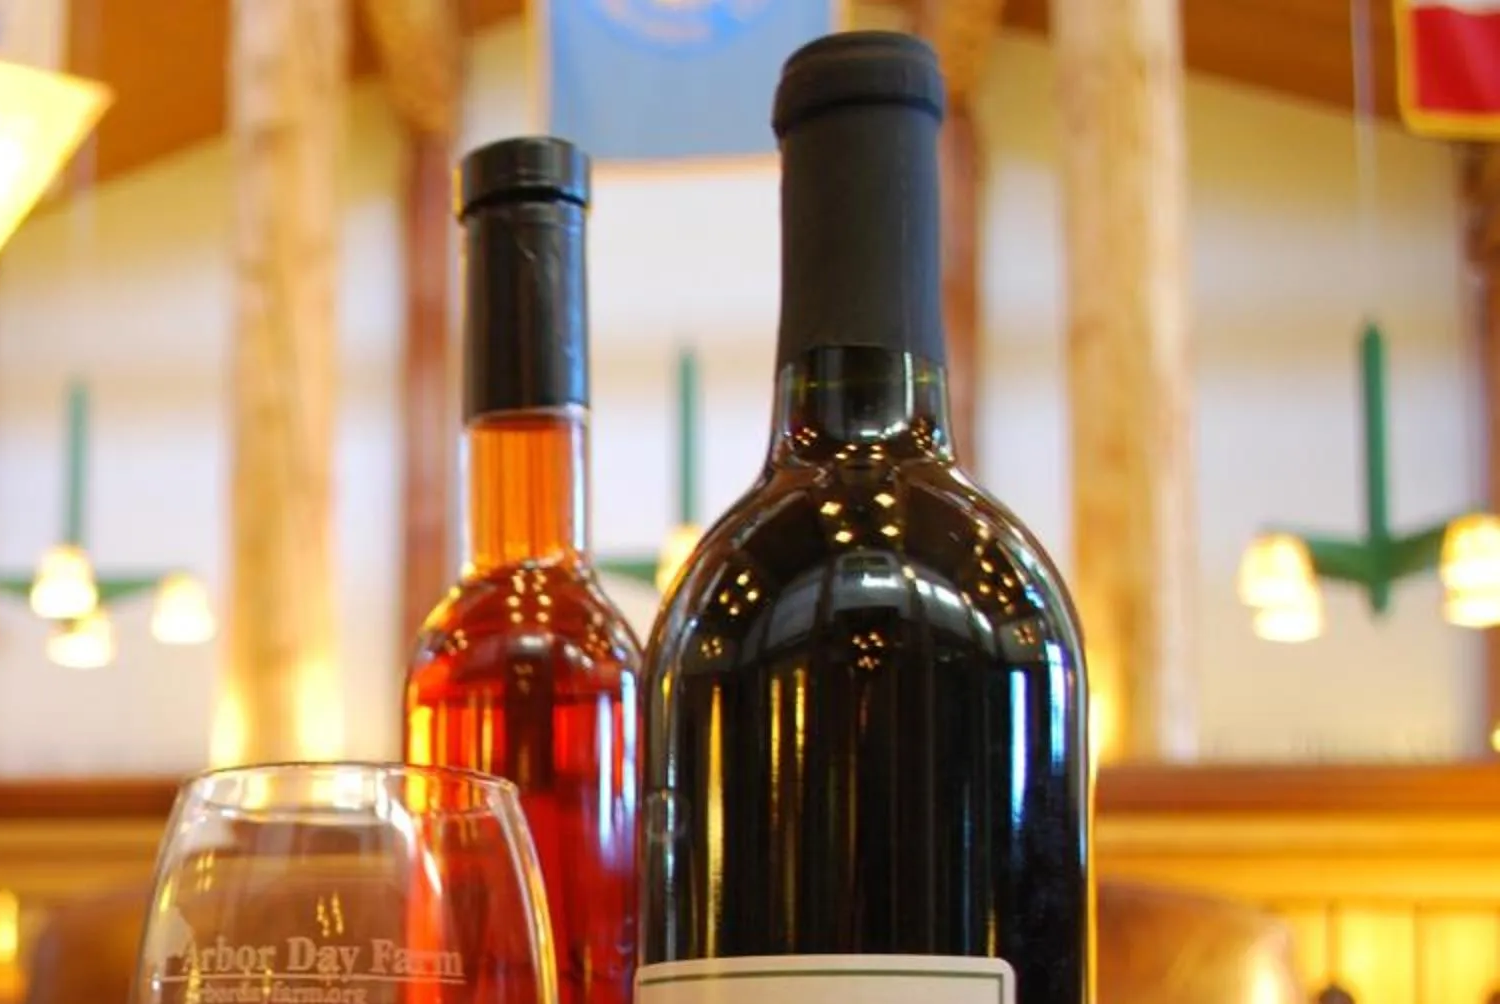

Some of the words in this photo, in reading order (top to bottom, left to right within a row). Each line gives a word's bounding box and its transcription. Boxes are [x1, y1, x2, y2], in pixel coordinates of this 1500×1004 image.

[180, 935, 277, 973] Arbor
[286, 936, 361, 983] Day
[368, 938, 467, 977] Farm
